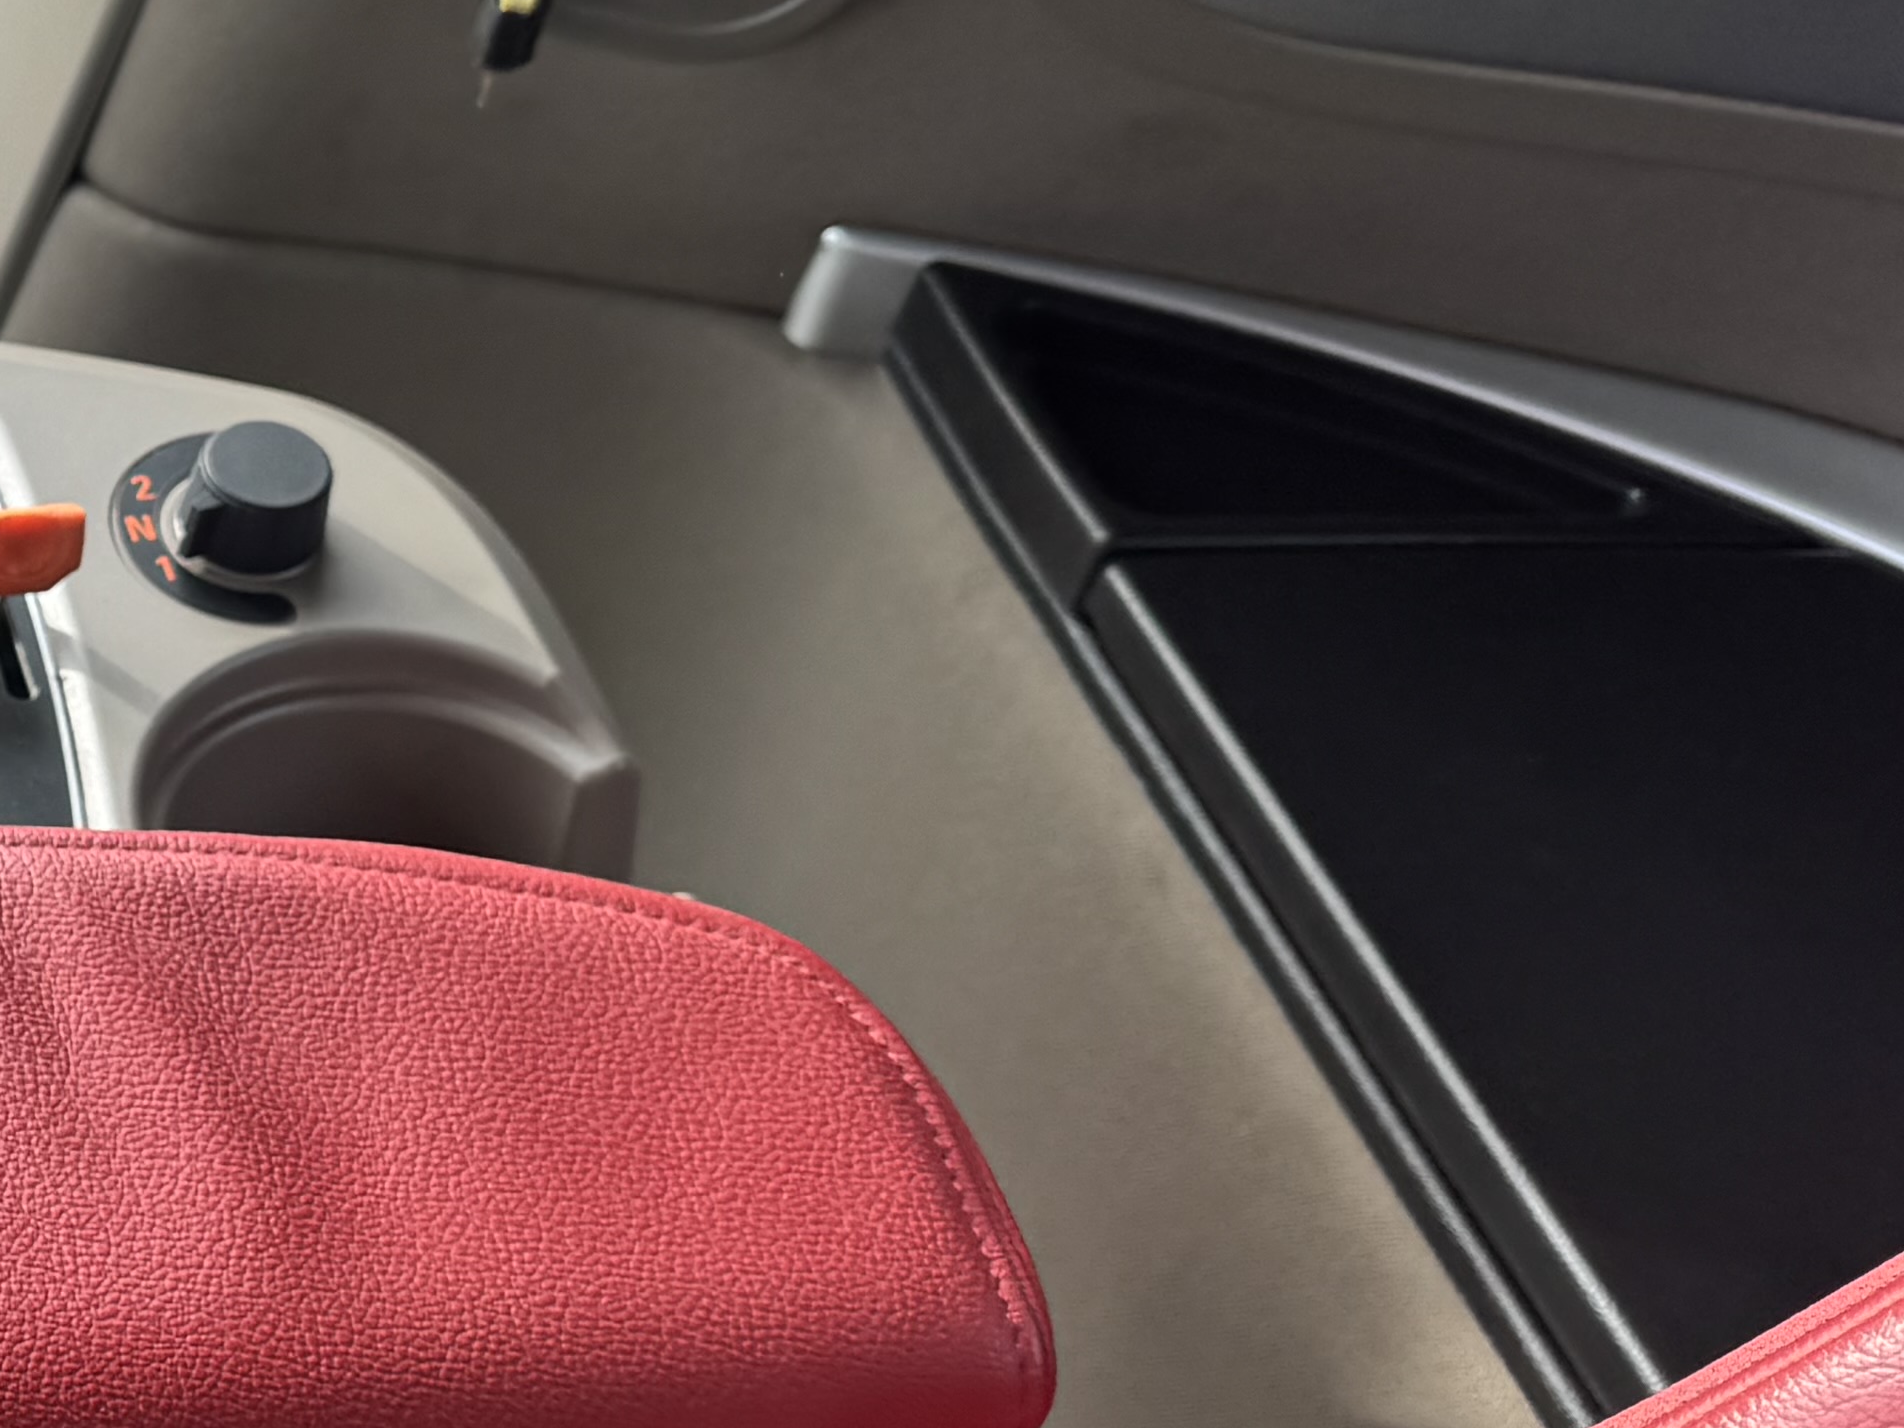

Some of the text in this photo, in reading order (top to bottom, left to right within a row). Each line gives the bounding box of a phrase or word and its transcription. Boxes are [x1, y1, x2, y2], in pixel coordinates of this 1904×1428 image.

[130, 474, 159, 502] 2
[124, 514, 157, 543] N
[155, 555, 177, 582] 1
